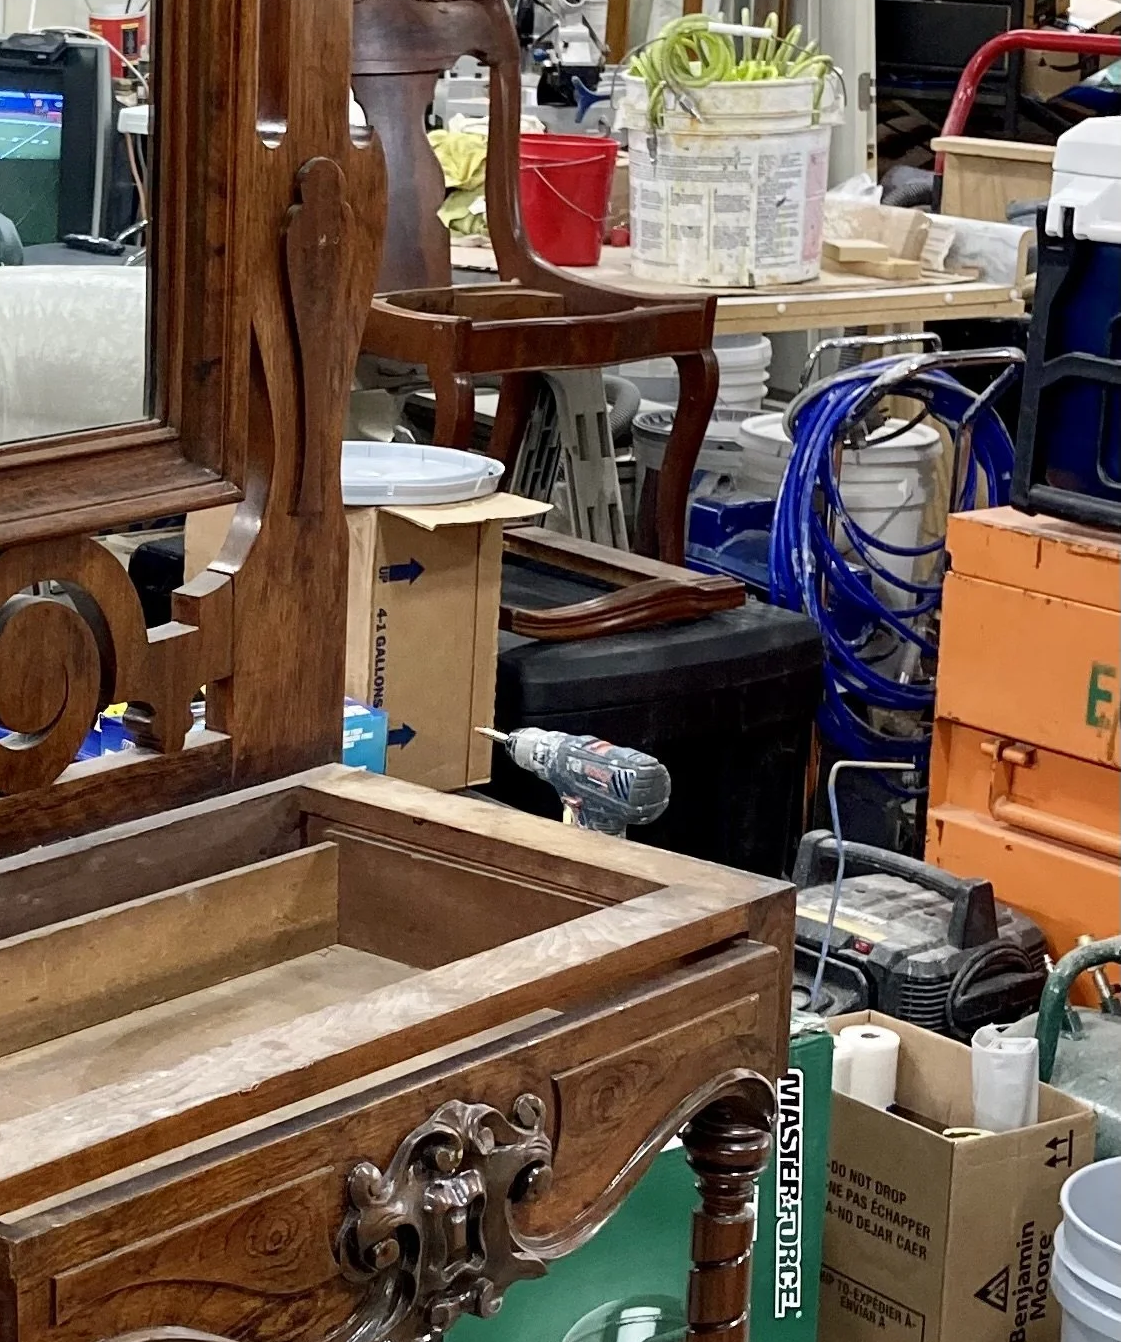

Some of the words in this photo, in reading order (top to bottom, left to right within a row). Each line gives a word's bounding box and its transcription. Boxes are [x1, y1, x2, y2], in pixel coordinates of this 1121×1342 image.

[375, 607, 388, 633] 4-1
[372, 635, 387, 709] GALLONS
[849, 1168, 872, 1190] NOT
[875, 1180, 907, 1205] DROP
[845, 1188, 868, 1210] PAS
[870, 1198, 931, 1242] ÉCHAPPER
[856, 1215, 894, 1245] DEJAR
[896, 1232, 928, 1261] CAER
[1029, 1233, 1053, 1321] Moore
[839, 1295, 876, 1324] ENVIAR
